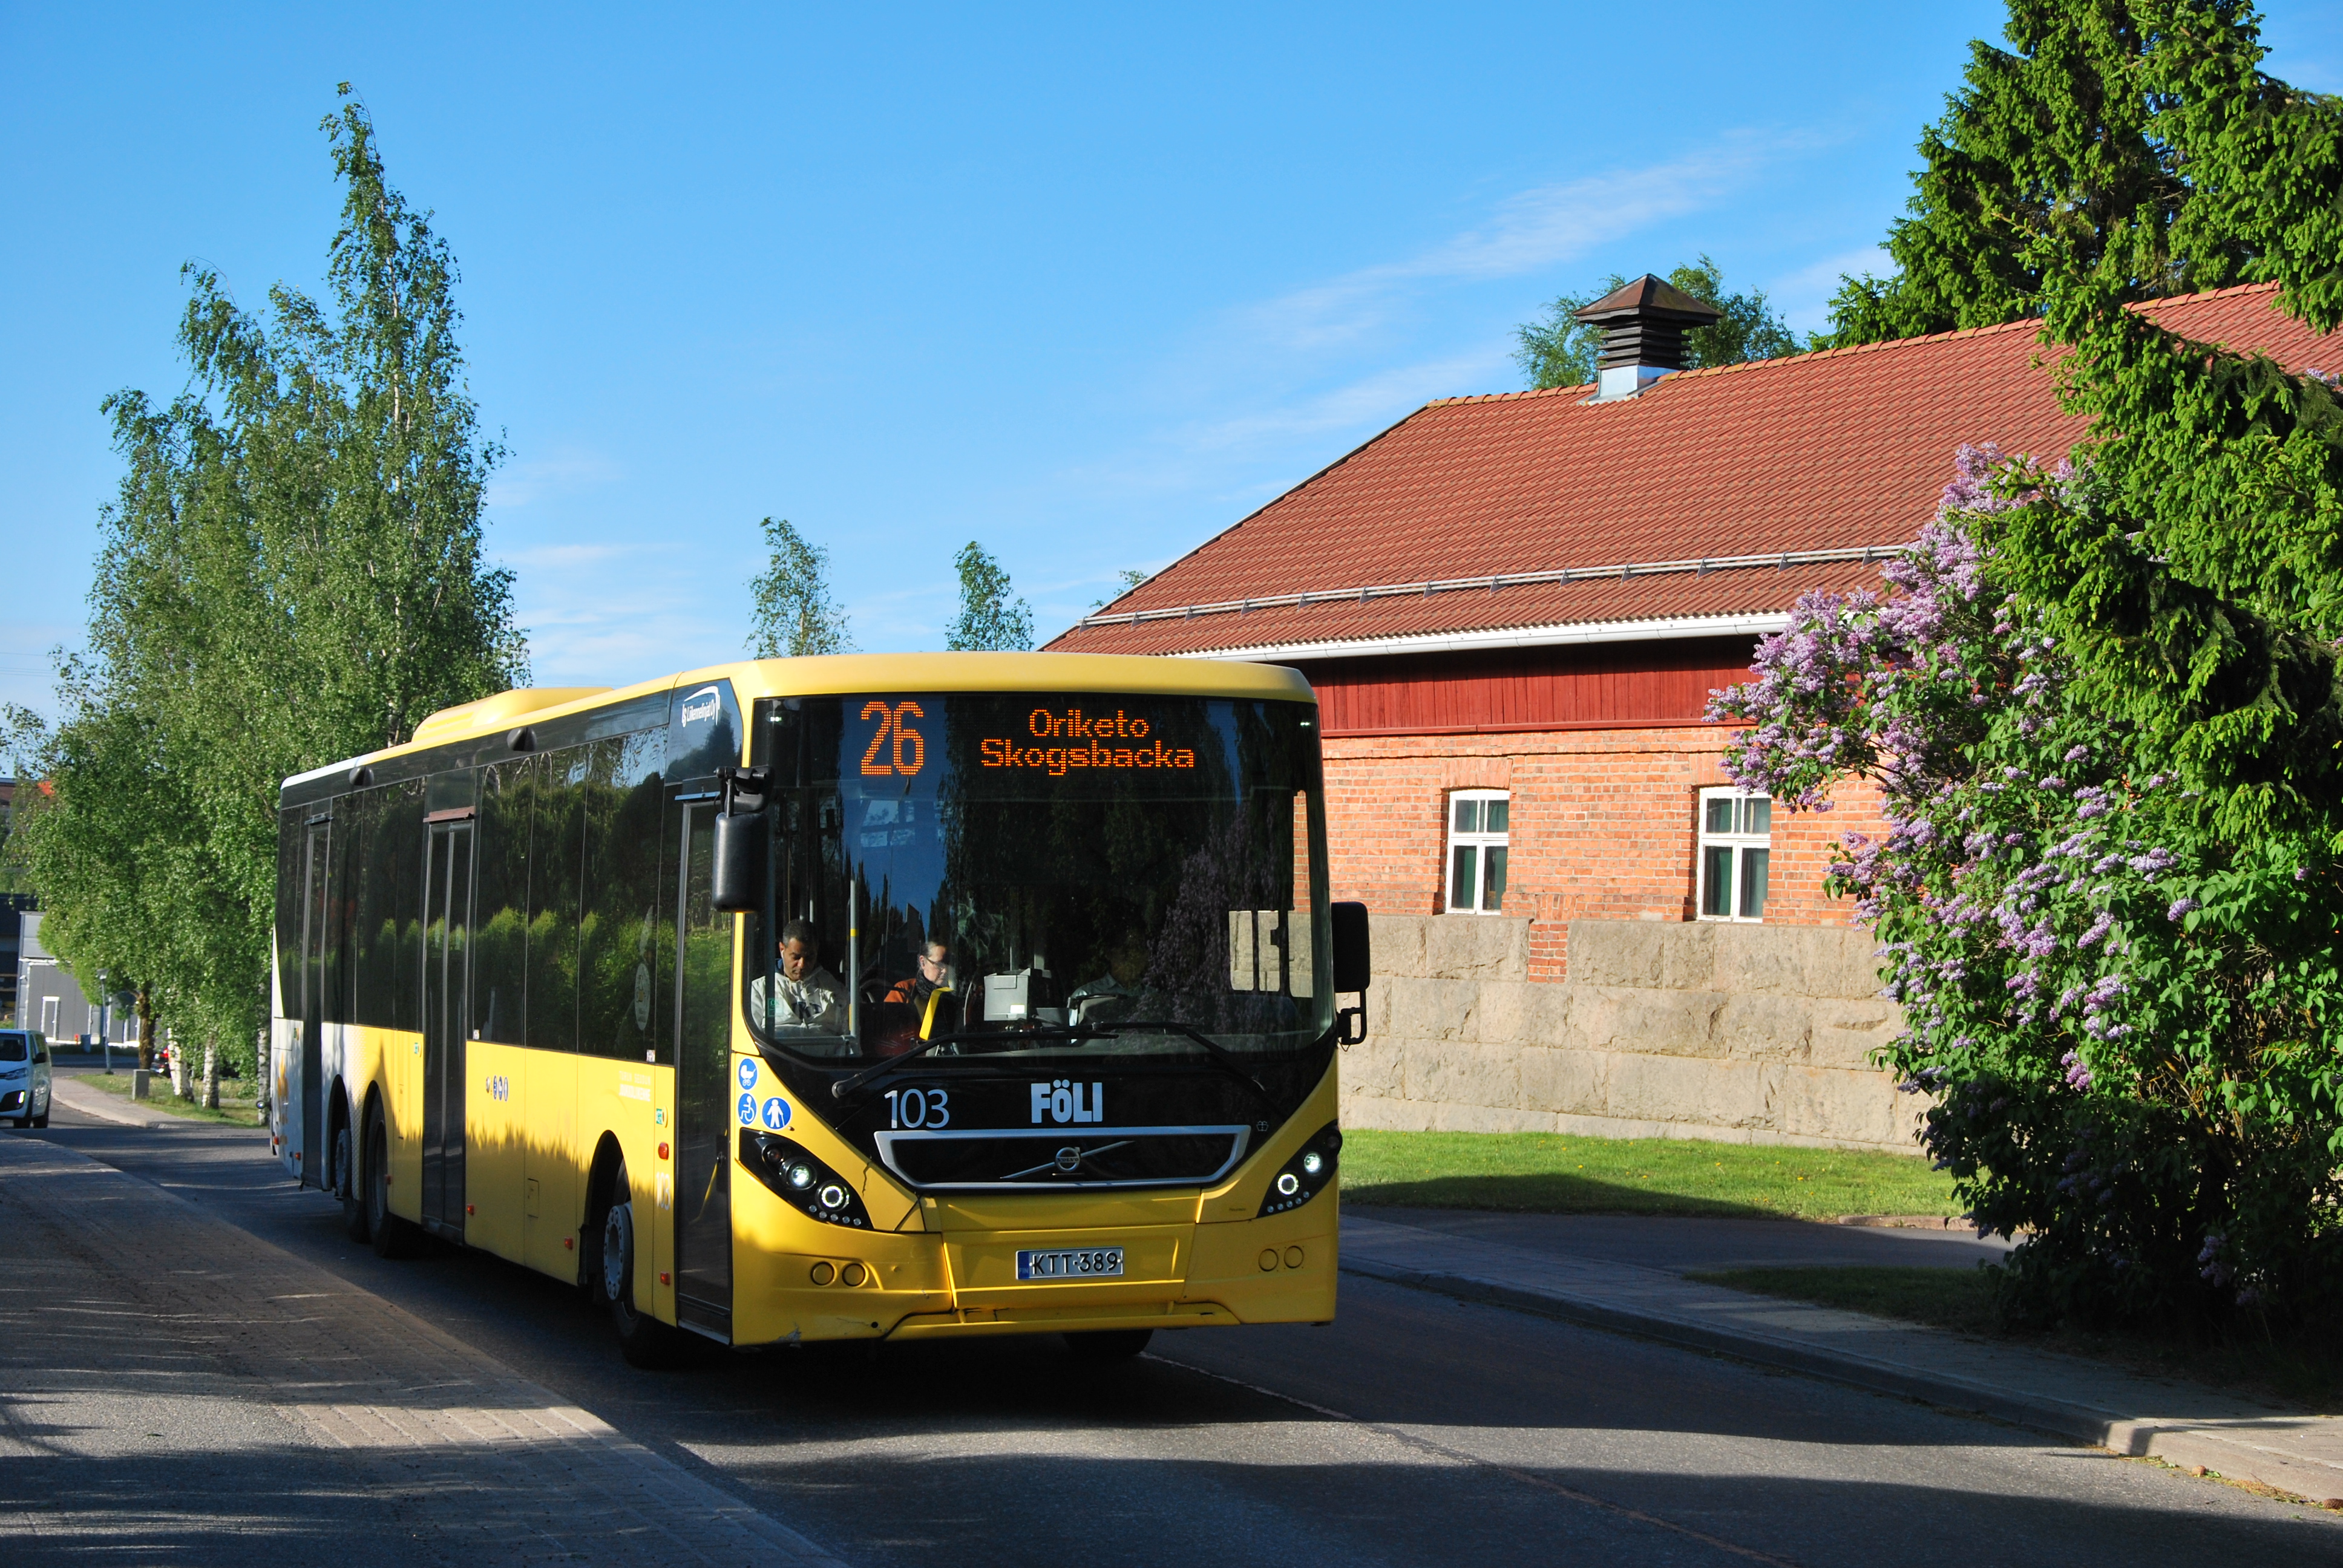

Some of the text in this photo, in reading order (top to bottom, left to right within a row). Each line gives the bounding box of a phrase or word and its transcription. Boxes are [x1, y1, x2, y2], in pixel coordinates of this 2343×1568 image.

[860, 701, 923, 775] 26
[1029, 708, 1150, 737] Oriketo
[980, 738, 1195, 776] Skogsbacka
[883, 1088, 950, 1129] 103
[1031, 1079, 1103, 1123] FÖLI
[656, 1171, 670, 1211] 103
[1032, 1251, 1119, 1275] KTT-389
